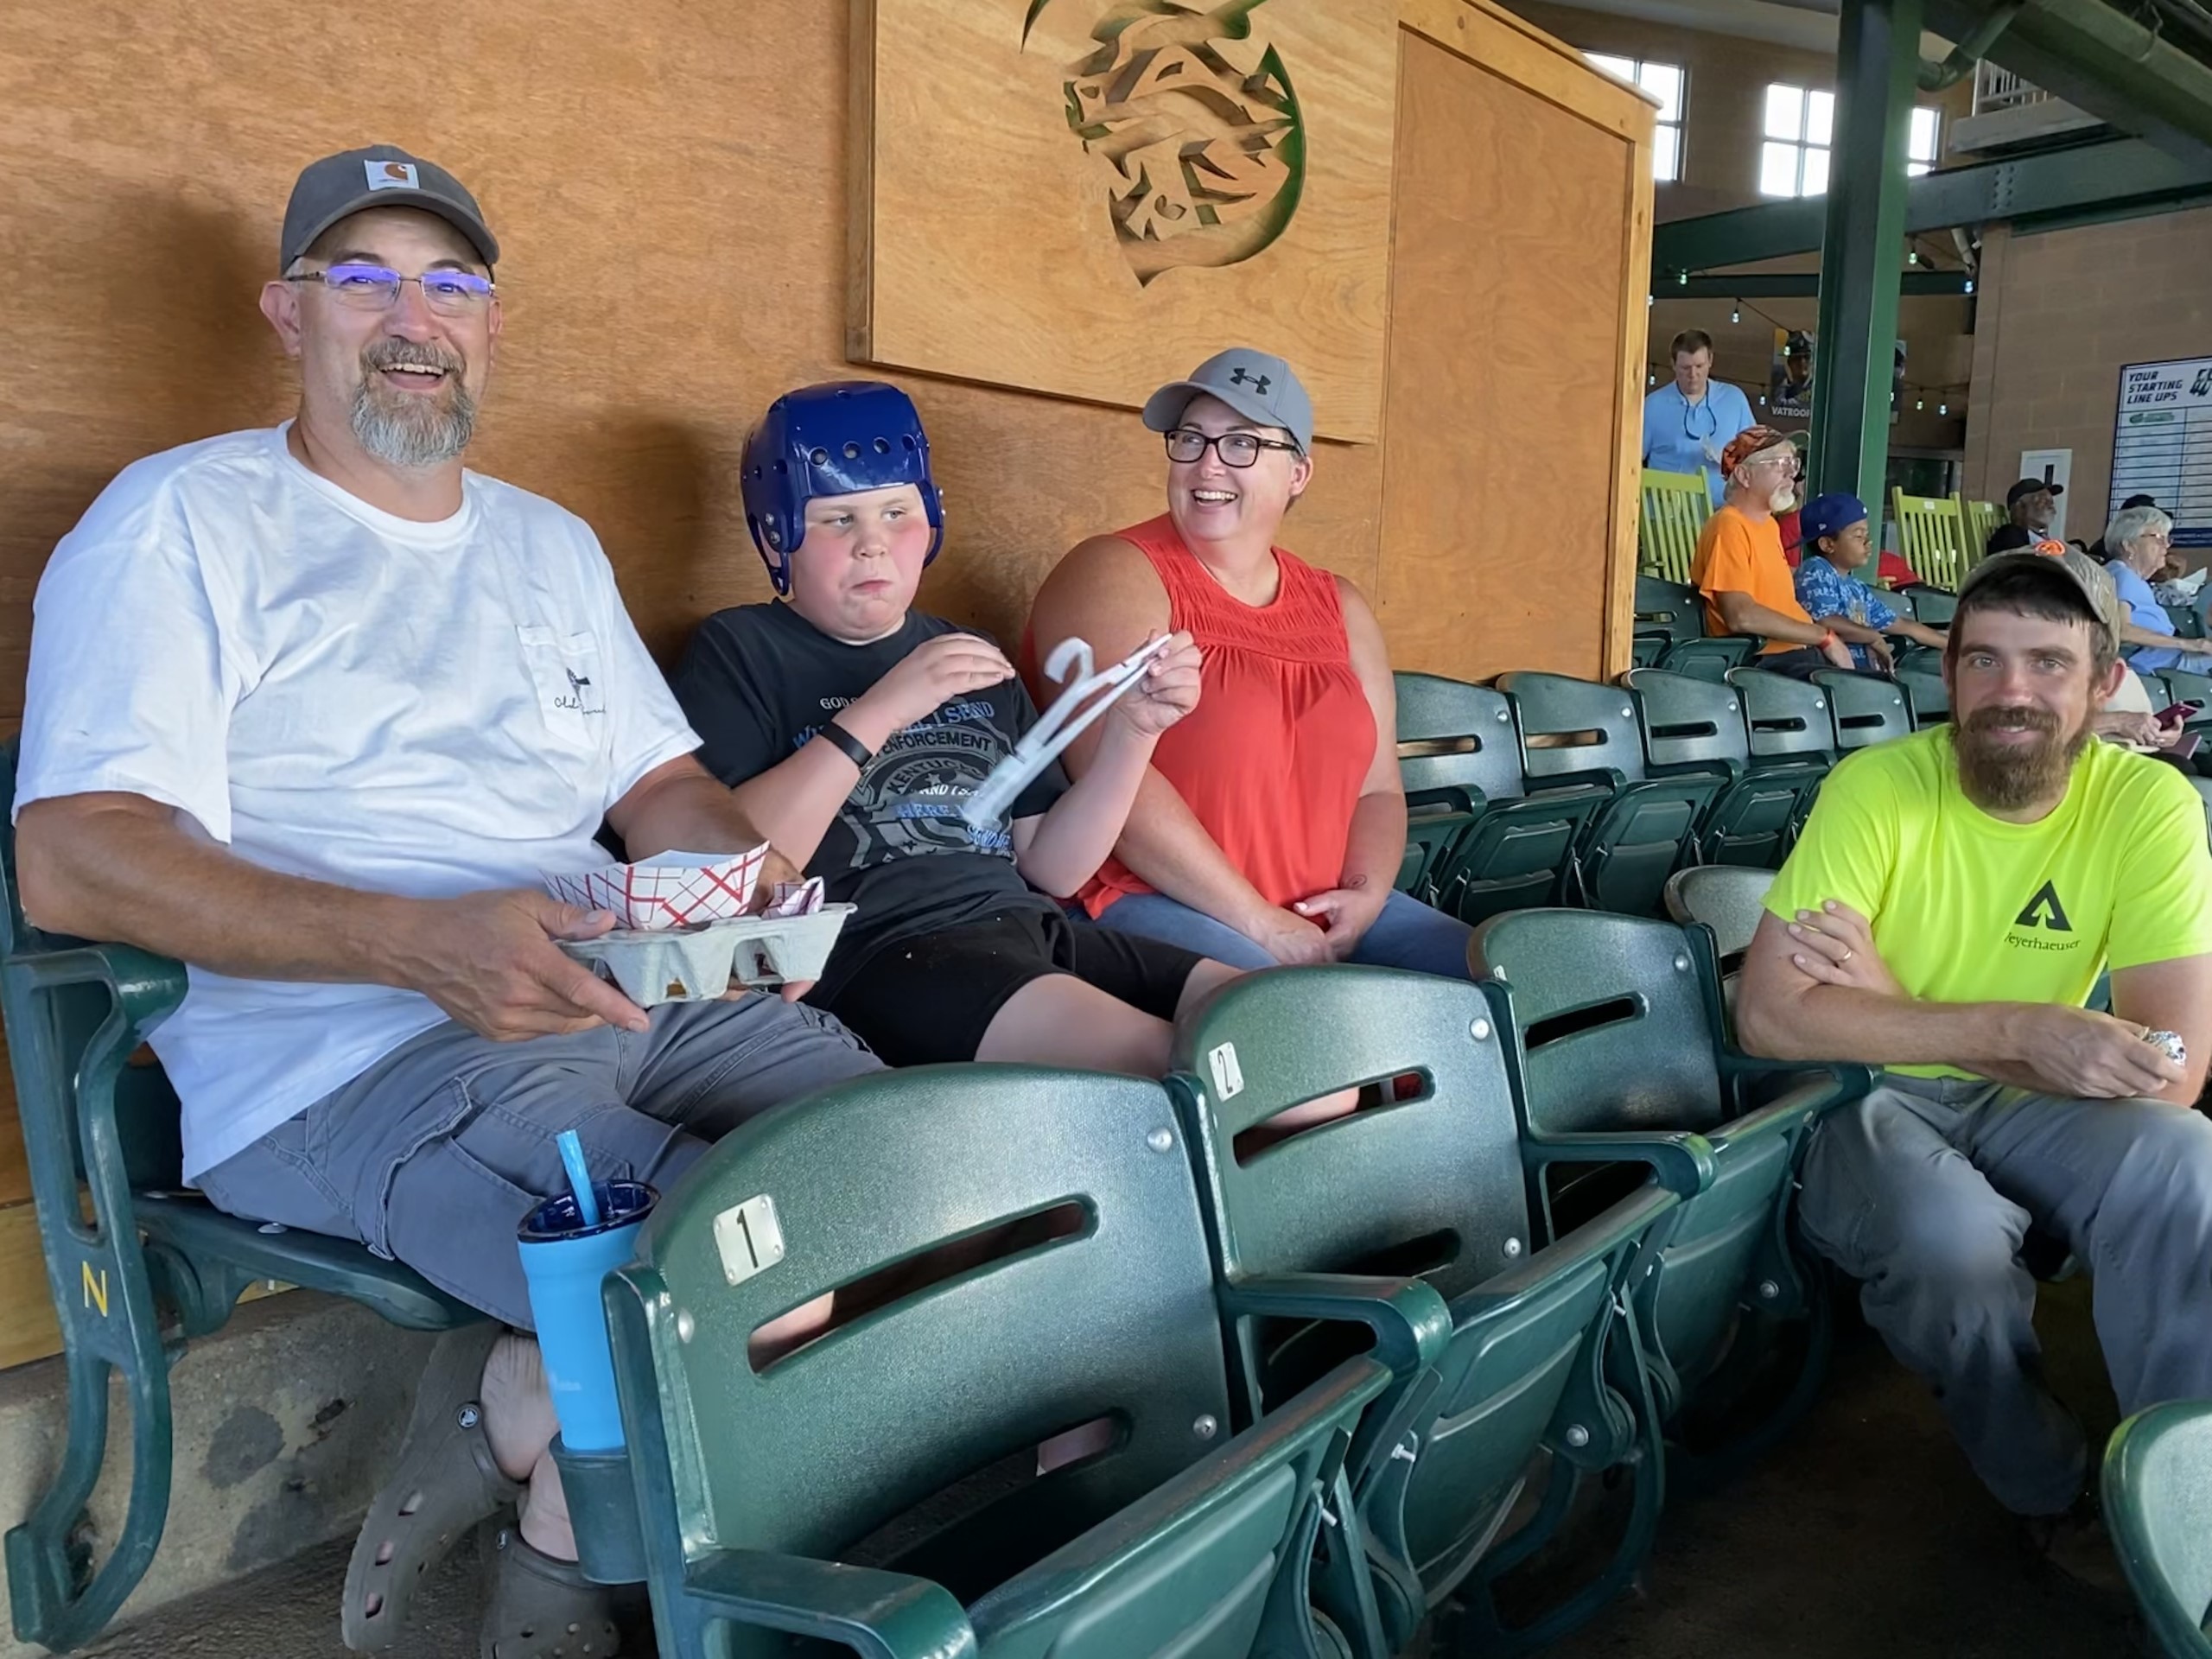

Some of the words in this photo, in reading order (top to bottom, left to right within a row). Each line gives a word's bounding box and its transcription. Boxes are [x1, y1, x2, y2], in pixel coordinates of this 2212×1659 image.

[2127, 379, 2183, 393] STARTING
[2129, 371, 2159, 382] YOUR
[2126, 393, 2153, 404] LINE
[2154, 391, 2178, 402] UPS
[820, 696, 849, 710] GOD
[944, 701, 995, 723] SEND
[882, 731, 993, 754] ENFORCEMENT
[1217, 1049, 1234, 1095] 2
[736, 1208, 759, 1269] 1
[82, 1260, 108, 1318] N
